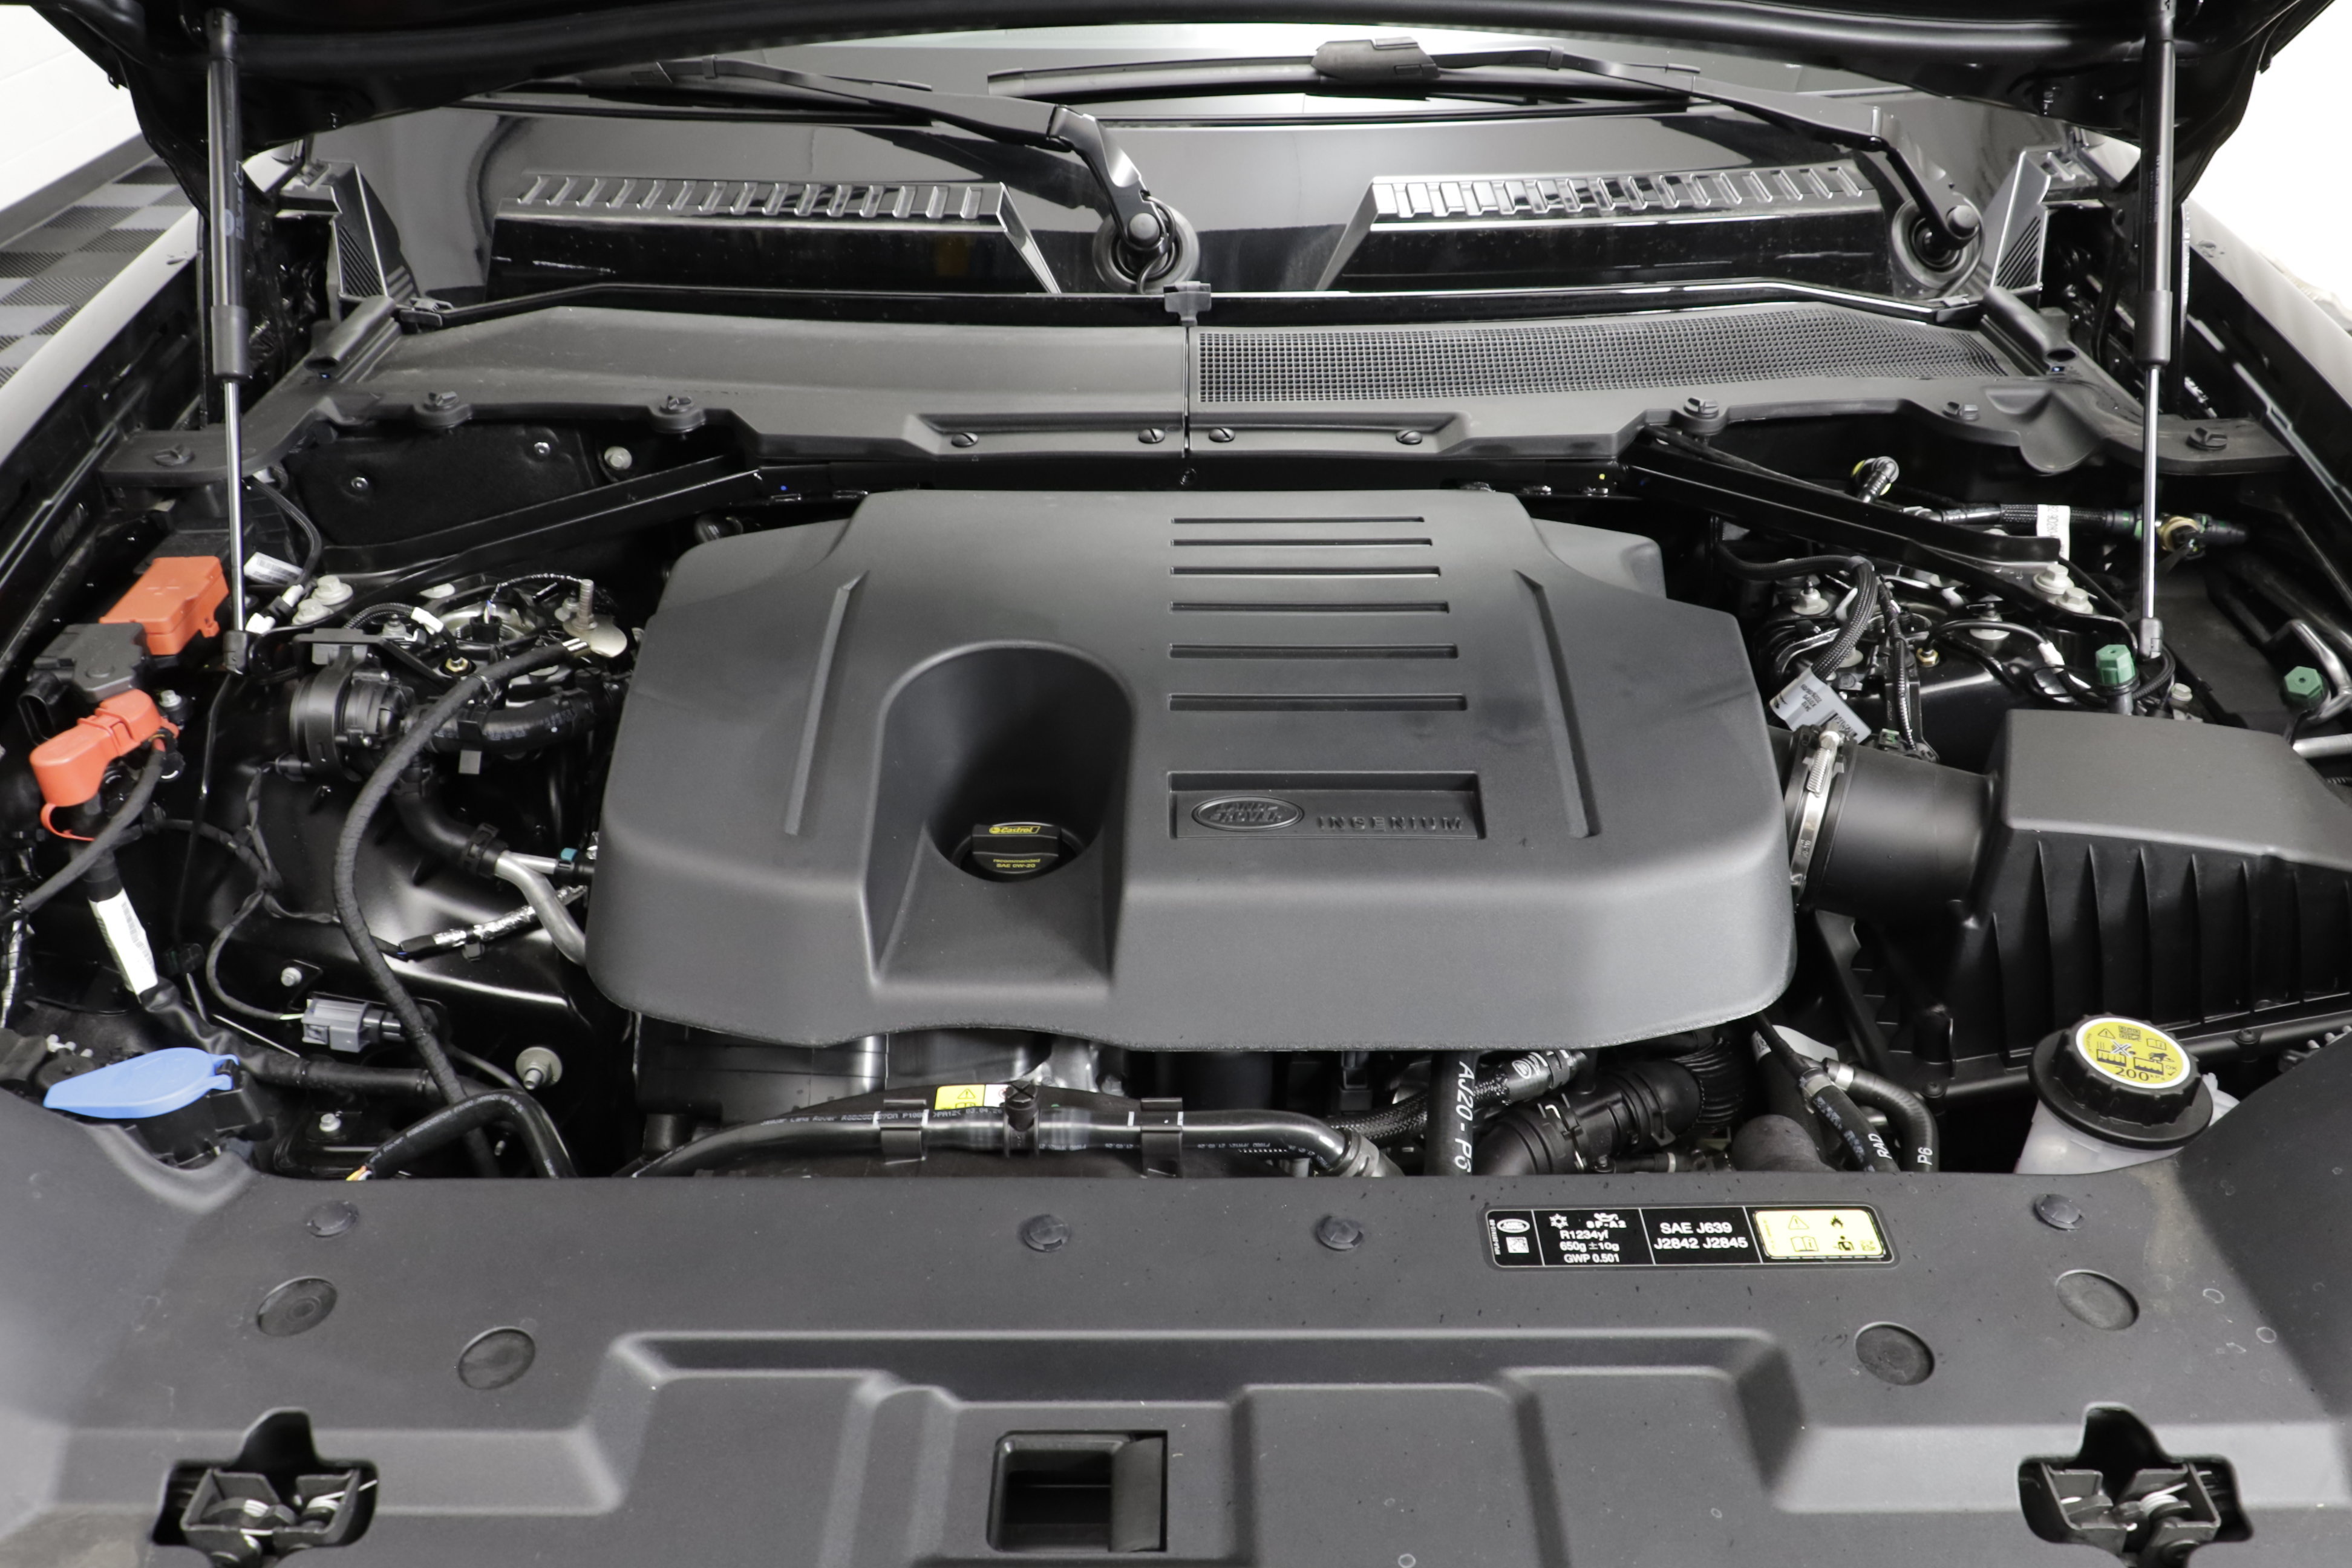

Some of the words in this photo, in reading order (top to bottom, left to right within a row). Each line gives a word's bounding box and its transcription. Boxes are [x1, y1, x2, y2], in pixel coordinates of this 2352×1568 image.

[1317, 815, 1463, 832] INGENIUM
[2114, 1066, 2150, 1081] 200
[1455, 1061, 1475, 1122] AJ20
[1867, 1132, 1893, 1160] RAD
[1916, 1146, 1933, 1166] P6
[1586, 1220, 1627, 1229] SP-A2
[1660, 1222, 1693, 1234] SAE
[1696, 1221, 1733, 1234] J639
[1559, 1230, 1610, 1241] R1234yf
[1559, 1241, 1587, 1252] 650g
[1588, 1241, 1620, 1252] ±10g
[1653, 1237, 1700, 1250] J2842
[1702, 1236, 1749, 1249] J2845
[1563, 1253, 1590, 1264] GWP
[1592, 1253, 1620, 1263] 0.501
